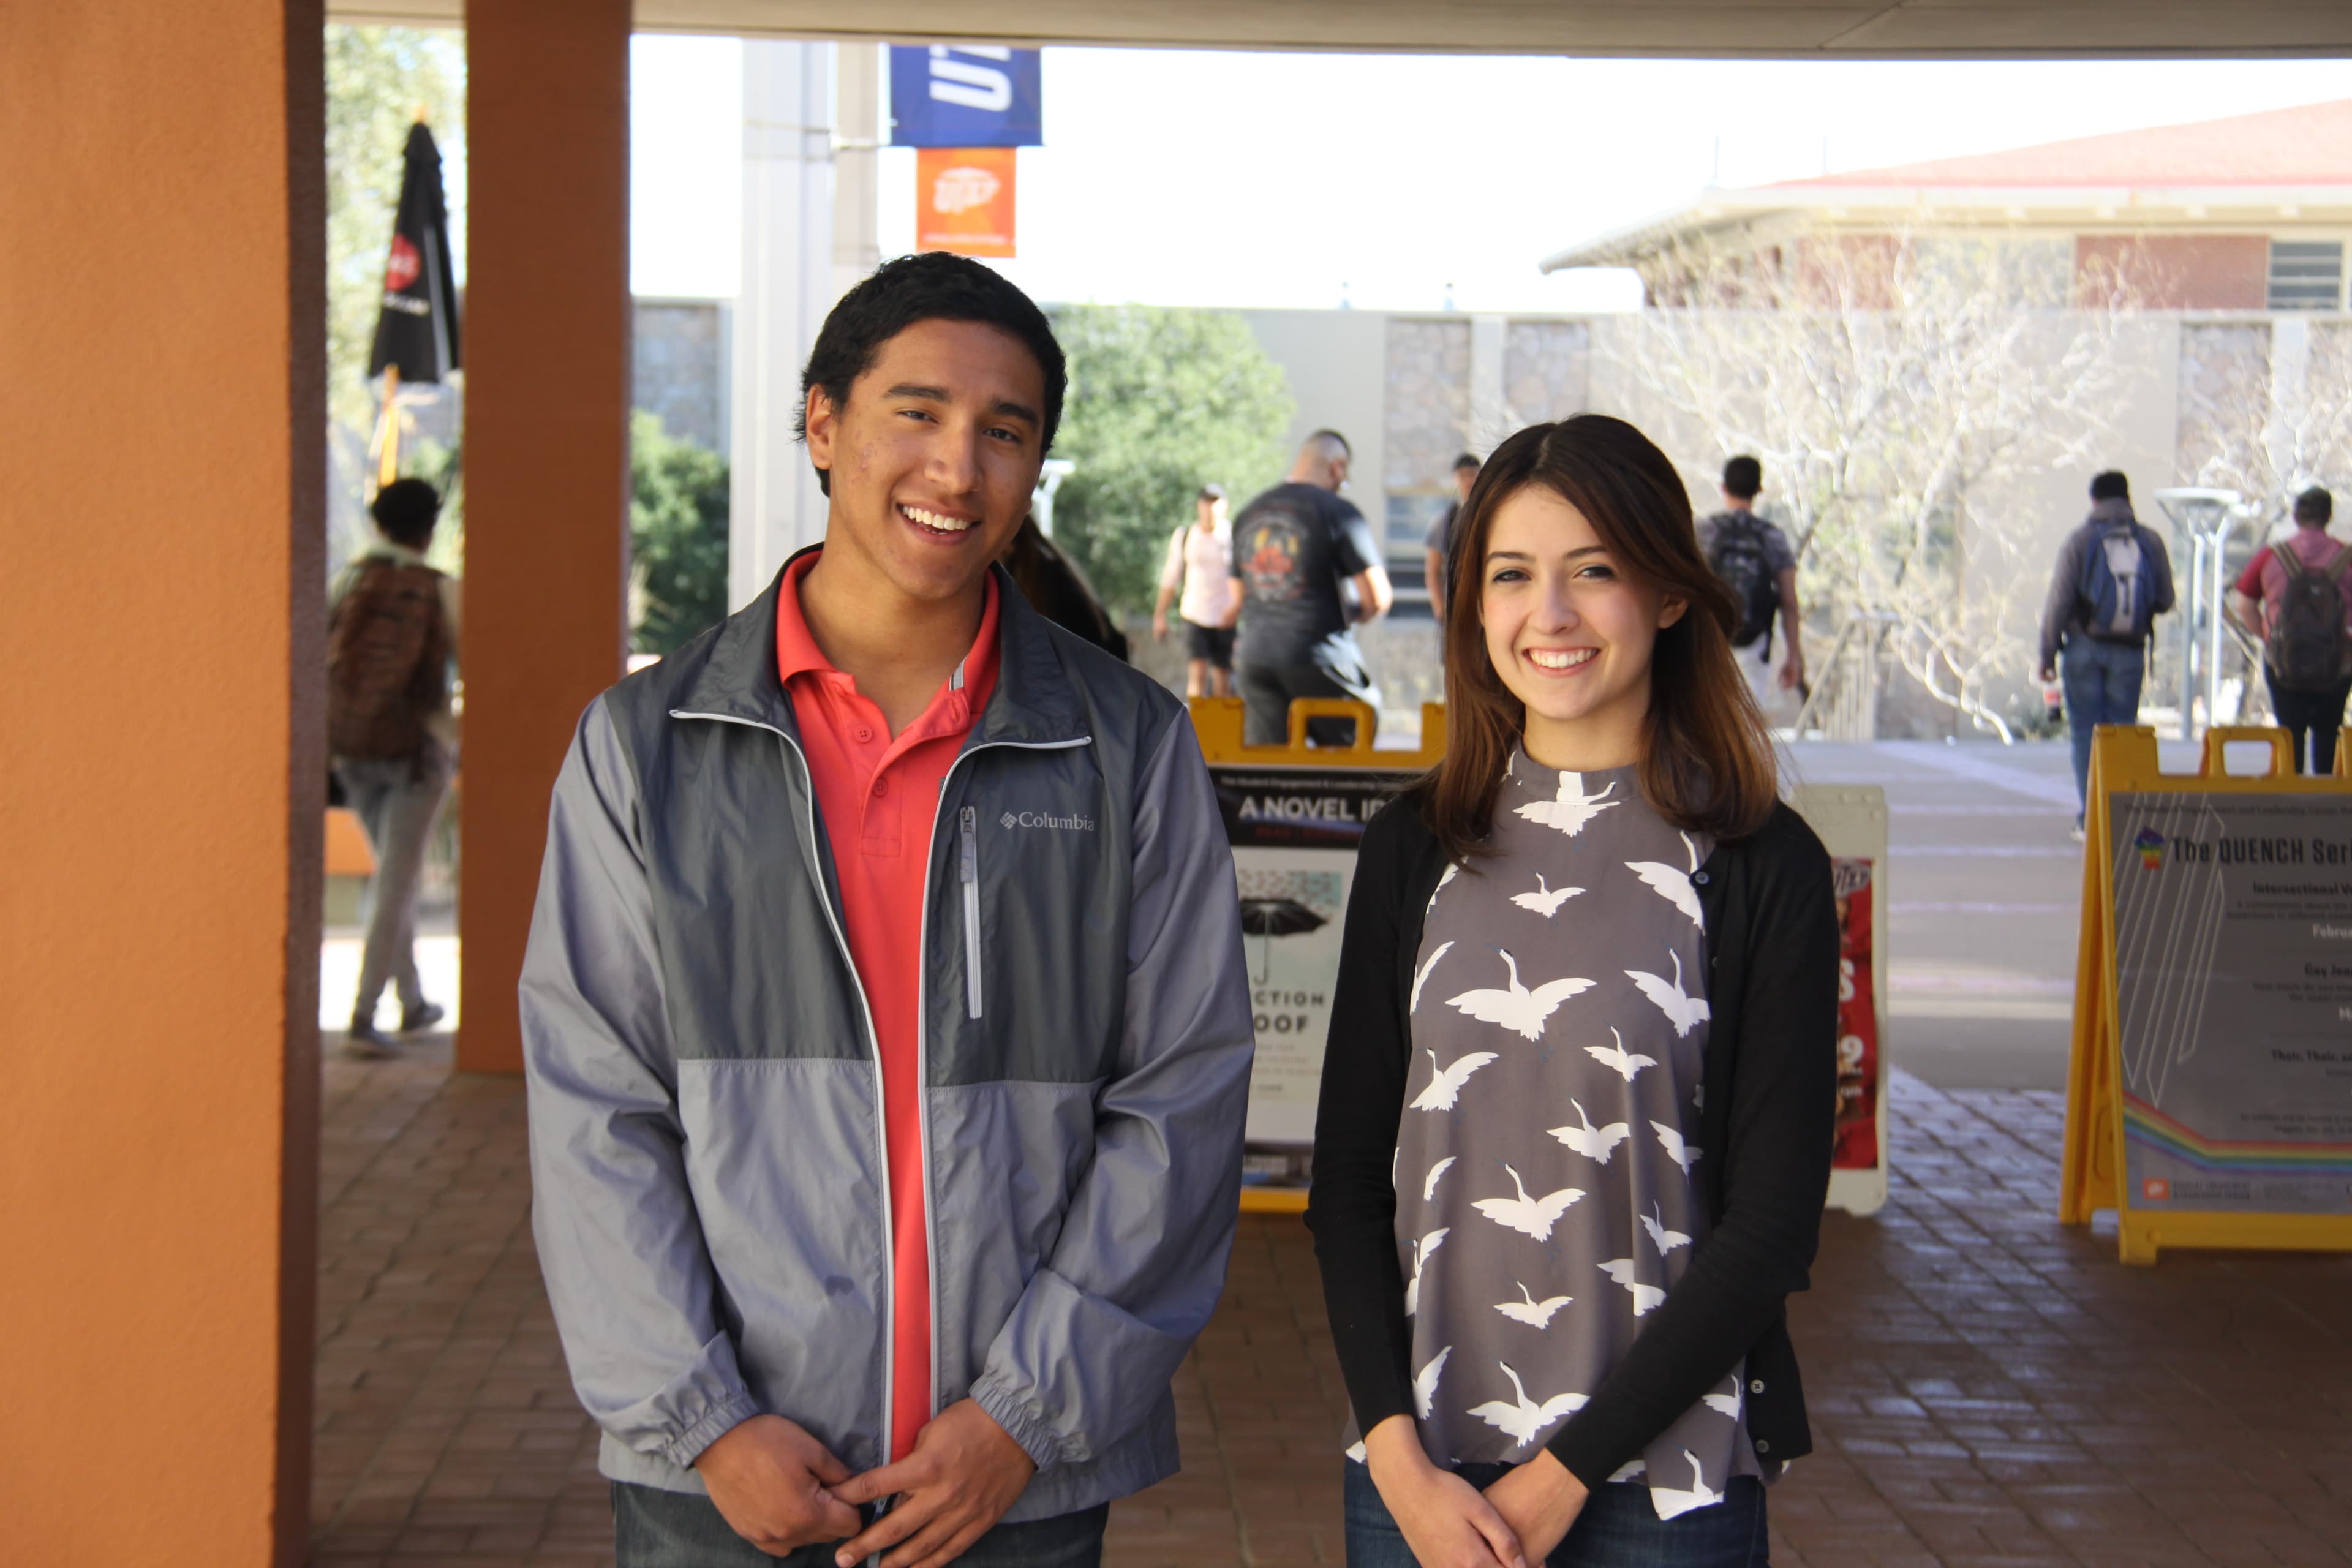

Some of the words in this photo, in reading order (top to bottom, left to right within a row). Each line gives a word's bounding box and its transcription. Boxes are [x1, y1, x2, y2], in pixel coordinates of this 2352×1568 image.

[1018, 811, 1095, 831] Columbia
[1238, 795, 1257, 819] A
[1264, 796, 1354, 822] NOVEL
[2173, 837, 2210, 864] The
[2219, 837, 2304, 865] QUENCH
